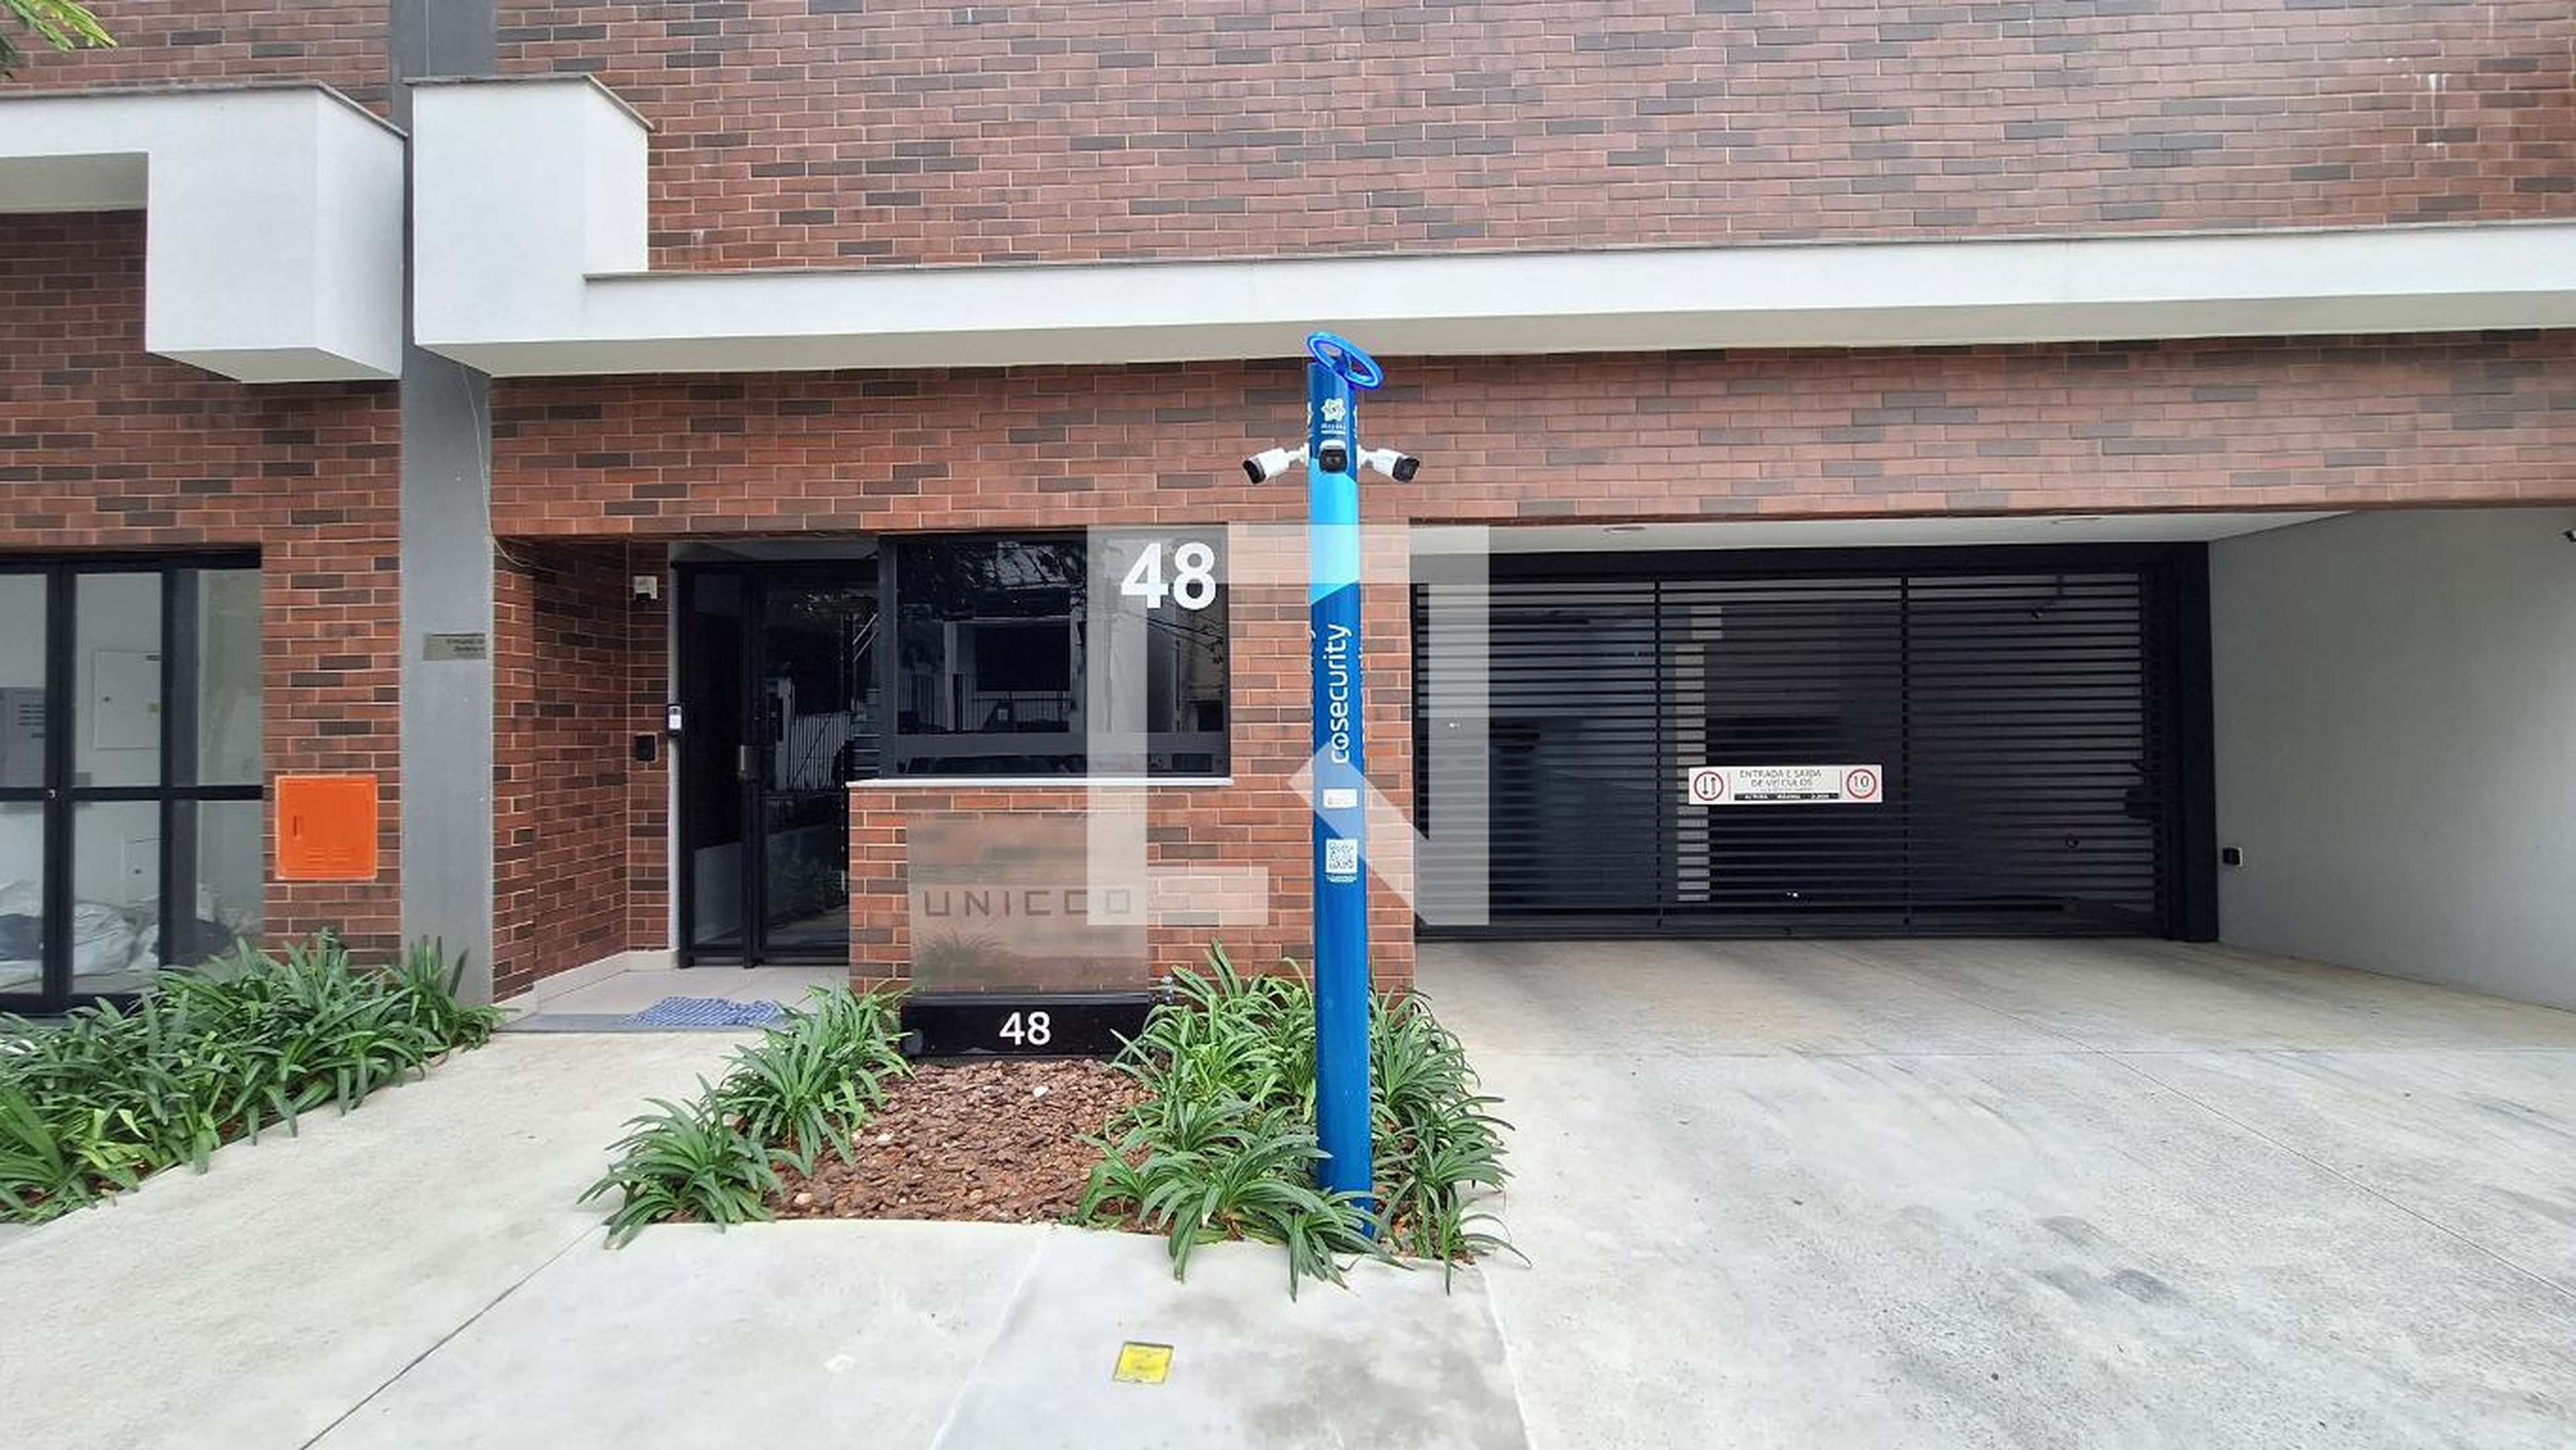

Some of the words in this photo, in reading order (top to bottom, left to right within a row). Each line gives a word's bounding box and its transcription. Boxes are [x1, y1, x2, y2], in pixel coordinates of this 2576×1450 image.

[1120, 542, 1216, 611] 48
[1323, 623, 1352, 764] cosecurity
[1739, 770, 1783, 778] ENTRADA
[1854, 776, 1869, 787] 10
[924, 889, 1131, 917] UNICCO
[999, 1011, 1051, 1046] 48
